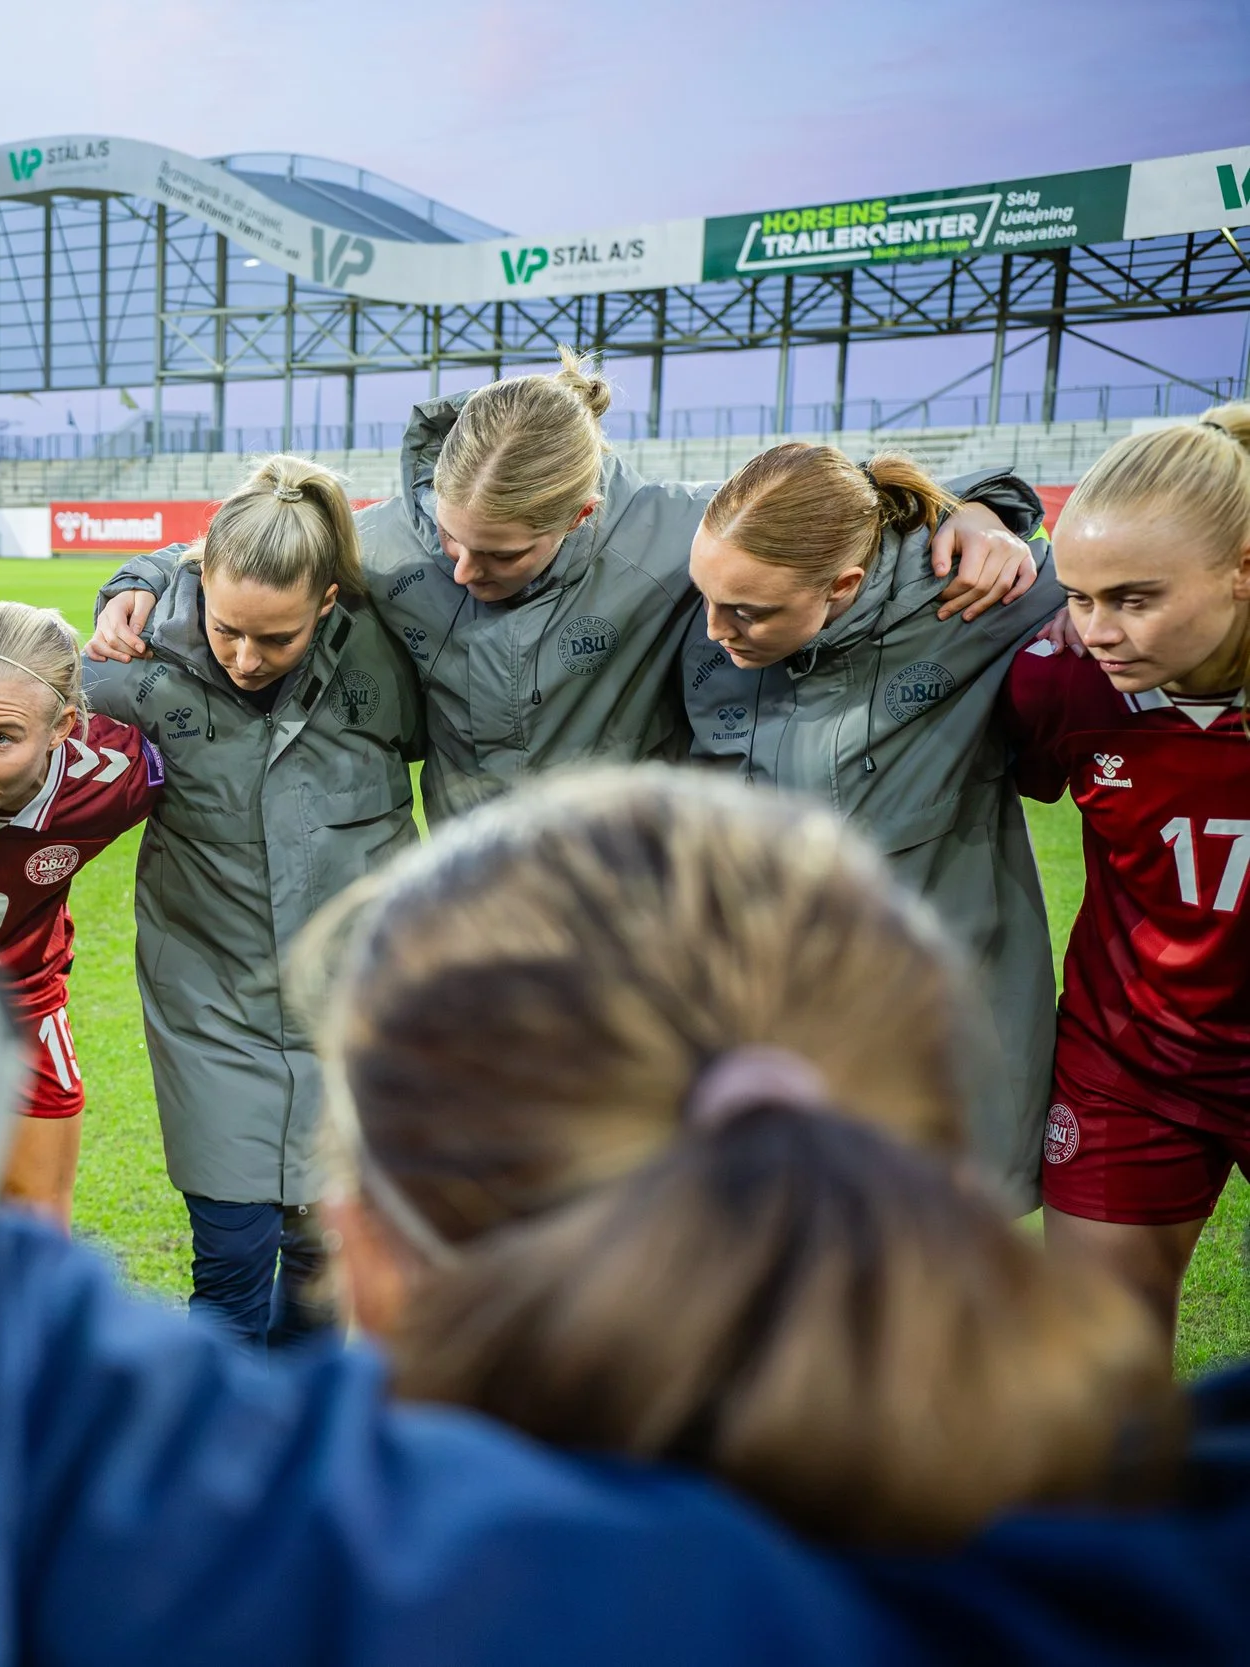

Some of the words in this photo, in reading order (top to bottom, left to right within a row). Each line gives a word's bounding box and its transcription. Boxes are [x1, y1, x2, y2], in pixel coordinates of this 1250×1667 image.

[9, 147, 43, 181] VP
[1006, 190, 1040, 207] Salg
[1216, 164, 1250, 210] V
[763, 201, 886, 234] HORSENS
[1000, 206, 1073, 226] Udlejning
[762, 213, 978, 257] TRAILERCENTER
[994, 225, 1077, 246] Reparation
[311, 226, 374, 288] VP
[500, 247, 549, 285] VP
[553, 239, 601, 267] STÅL
[609, 240, 645, 260] A/S
[81, 511, 163, 541] hummel
[387, 568, 426, 601] salling
[570, 635, 608, 657] DBU
[135, 664, 169, 705] salling
[692, 651, 727, 691] salling
[899, 683, 942, 703] DBU
[167, 726, 201, 740] hummel
[712, 728, 750, 741] hummel
[1094, 774, 1132, 788] hummel
[36, 857, 69, 872] DBU
[1160, 816, 1250, 913] 17
